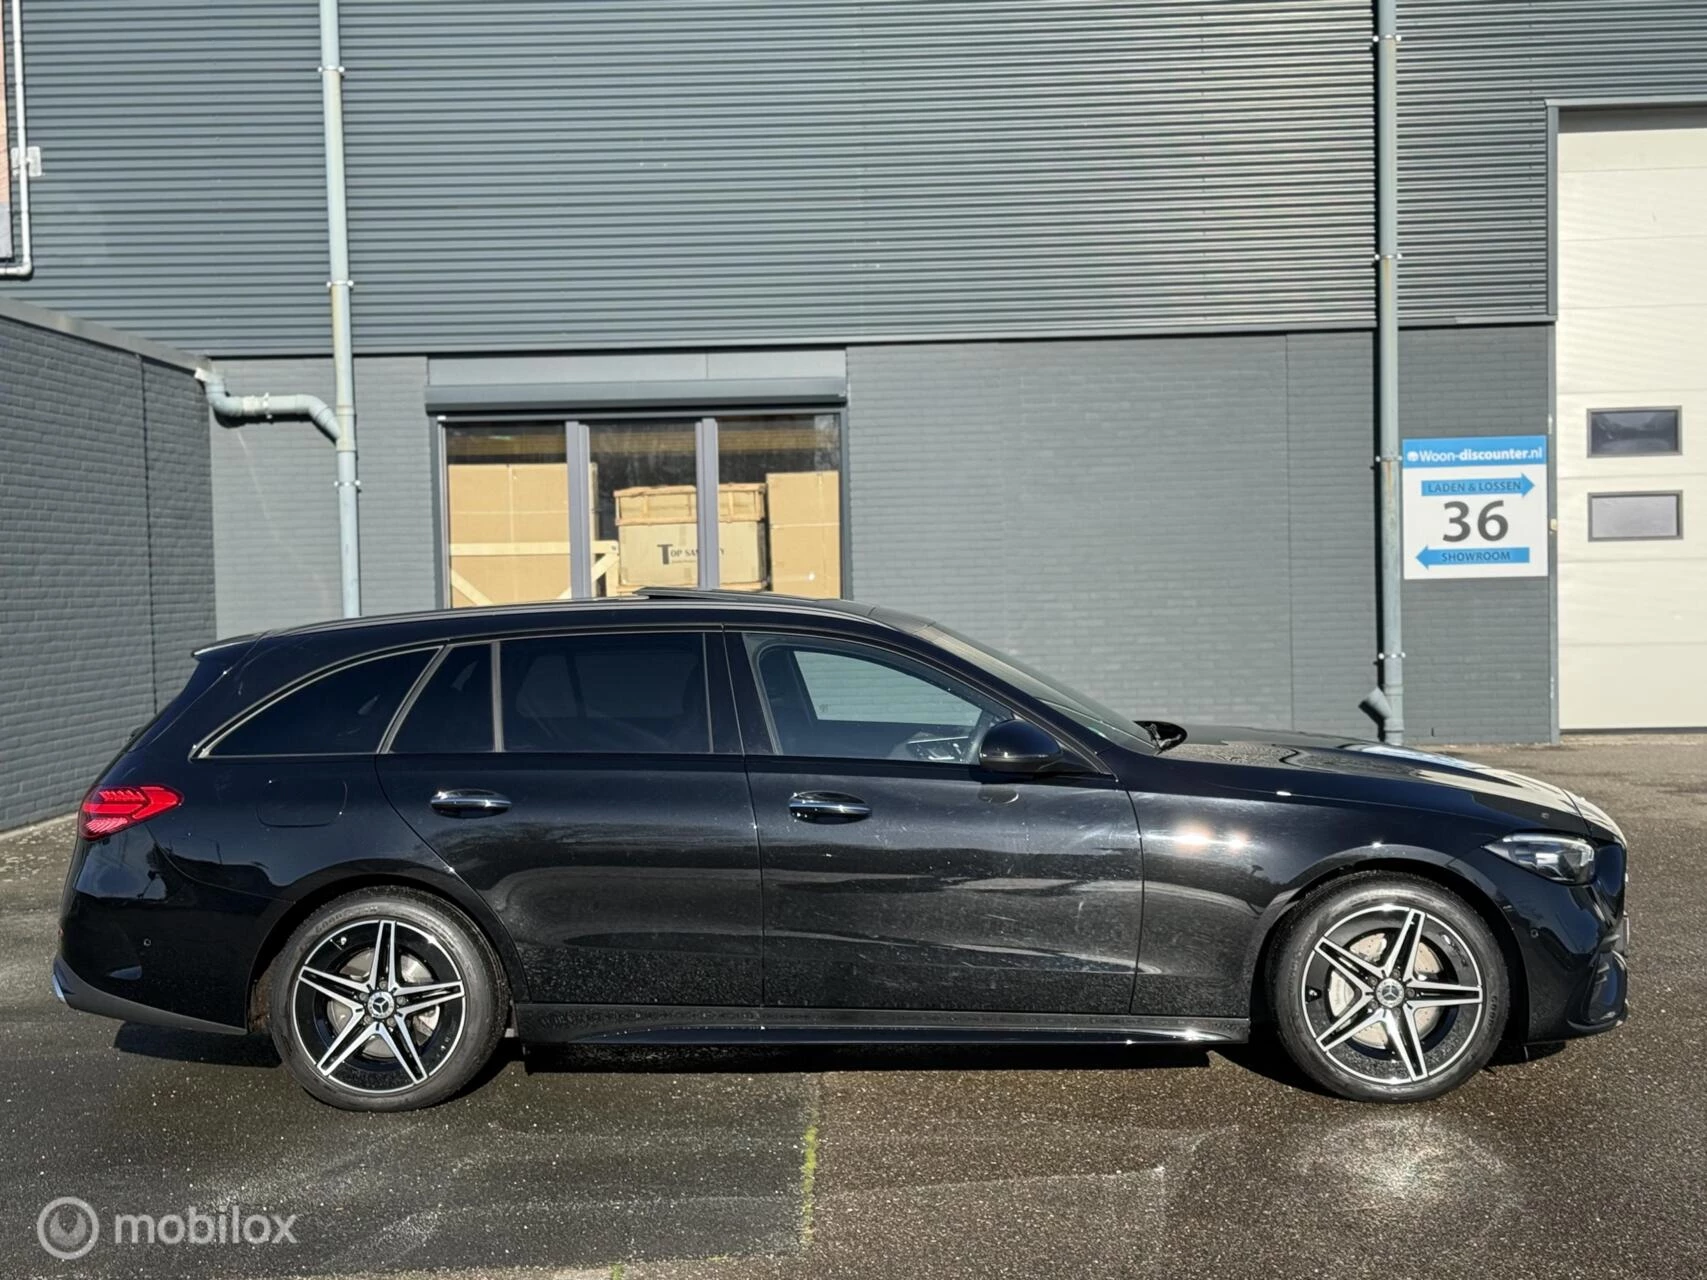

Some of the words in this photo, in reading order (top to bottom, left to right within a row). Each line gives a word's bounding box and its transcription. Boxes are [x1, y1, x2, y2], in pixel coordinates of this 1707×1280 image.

[1420, 447, 1542, 462] Woon-discounter.nl
[1428, 482, 1466, 493] LADEN
[1468, 482, 1477, 492] &
[1479, 481, 1521, 492] LOSSEN
[1442, 500, 1509, 542] 36
[656, 543, 682, 565] TOP
[1440, 551, 1511, 562] SHOWROOM
